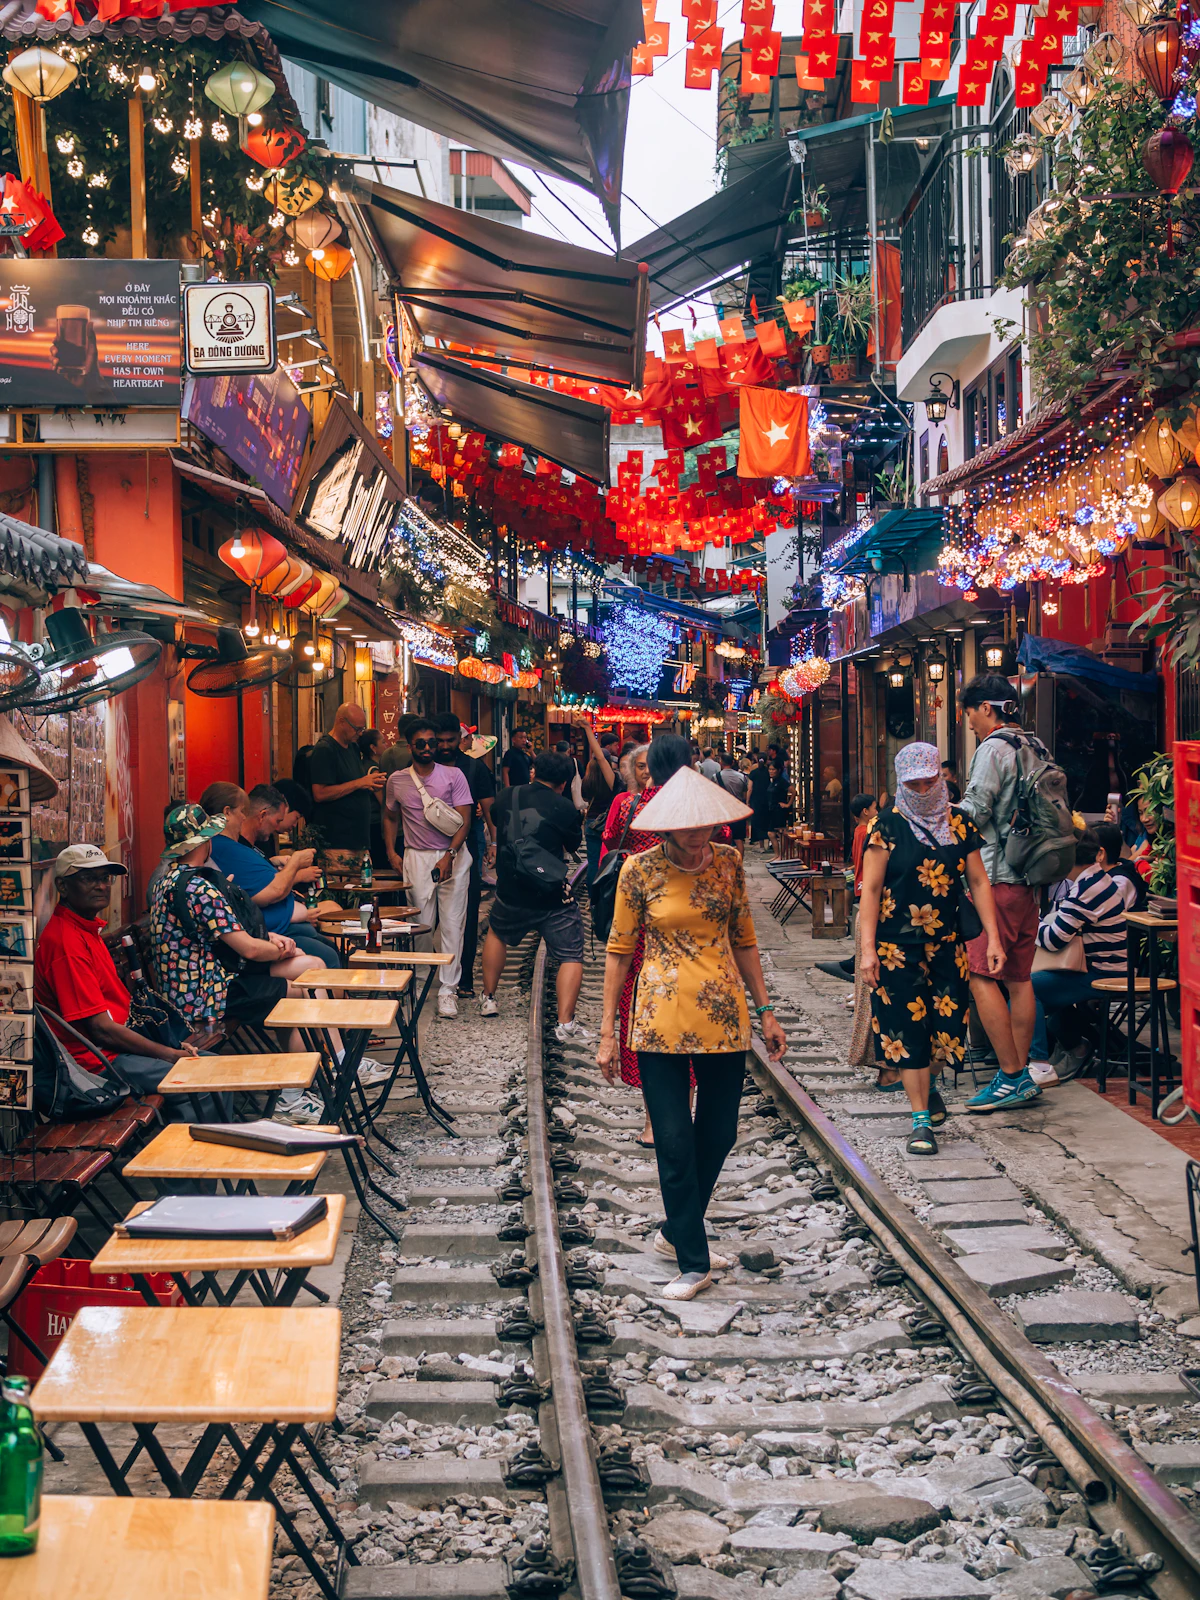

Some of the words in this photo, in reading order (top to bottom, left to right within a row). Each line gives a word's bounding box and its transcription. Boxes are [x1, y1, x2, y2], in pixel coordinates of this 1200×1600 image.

[134, 283, 151, 292] ĐÂY
[99, 296, 115, 305] MỌI
[117, 294, 152, 304] KHOẢNH
[141, 306, 155, 315] CÓ
[107, 319, 126, 328] NHỊP
[128, 319, 142, 327] TIM
[144, 318, 170, 327] RIÊNG
[126, 342, 150, 351] HERE
[194, 347, 205, 358] GA
[104, 354, 132, 363] EVERY
[134, 354, 172, 363] MOMENT
[113, 366, 131, 375] HAS
[133, 366, 141, 375] IT
[143, 366, 164, 375] OWN
[113, 379, 164, 388] HEARTBEAT
